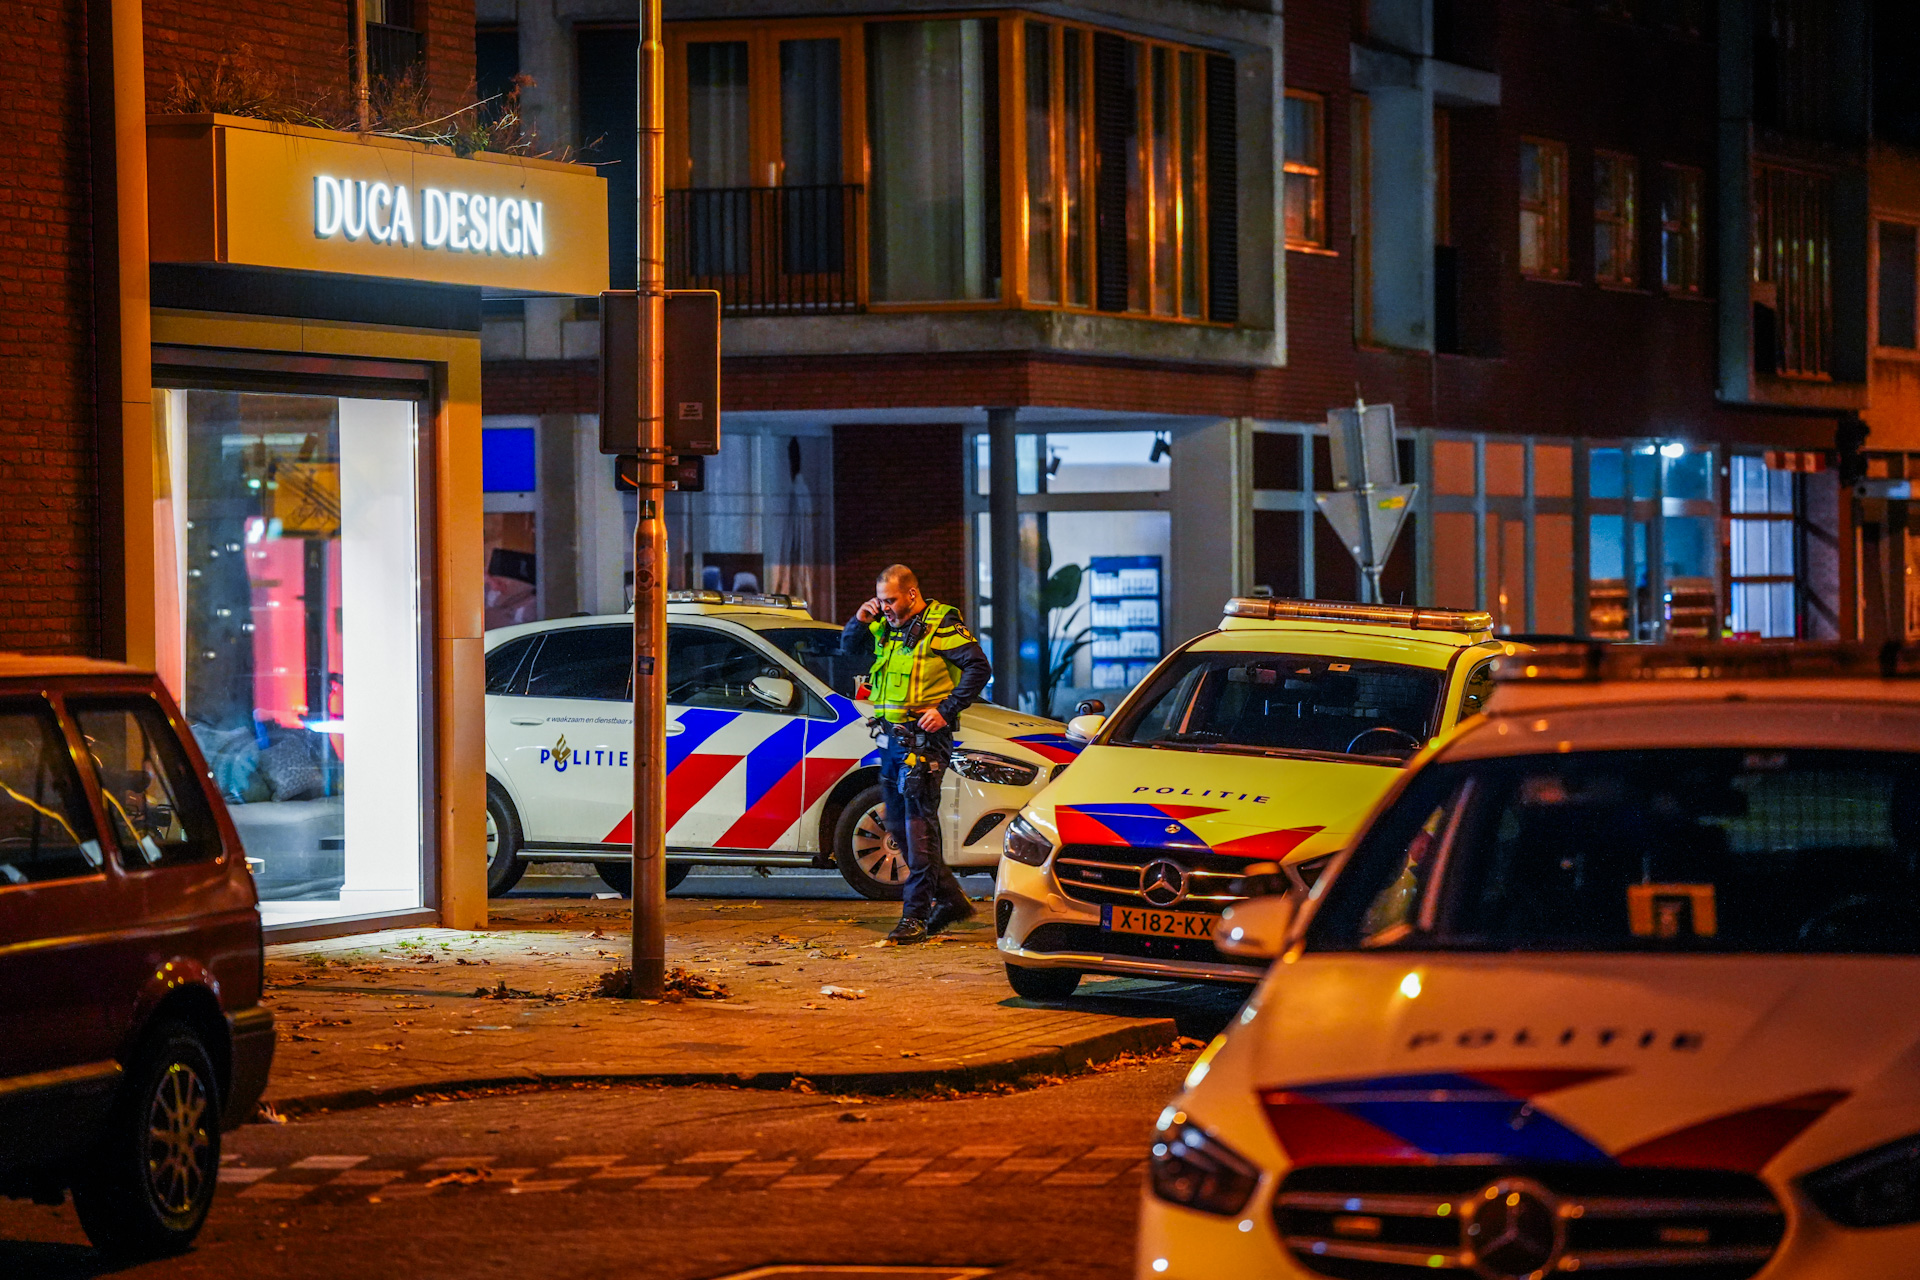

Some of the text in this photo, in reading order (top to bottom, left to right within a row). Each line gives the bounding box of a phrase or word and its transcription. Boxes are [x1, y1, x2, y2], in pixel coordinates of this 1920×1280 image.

[314, 175, 544, 258] DUCA DESIGN
[551, 715, 585, 723] waakzaam
[540, 748, 628, 772] POLITIE
[1132, 786, 1271, 804] POLITIE
[1120, 909, 1212, 937] X-182-KX
